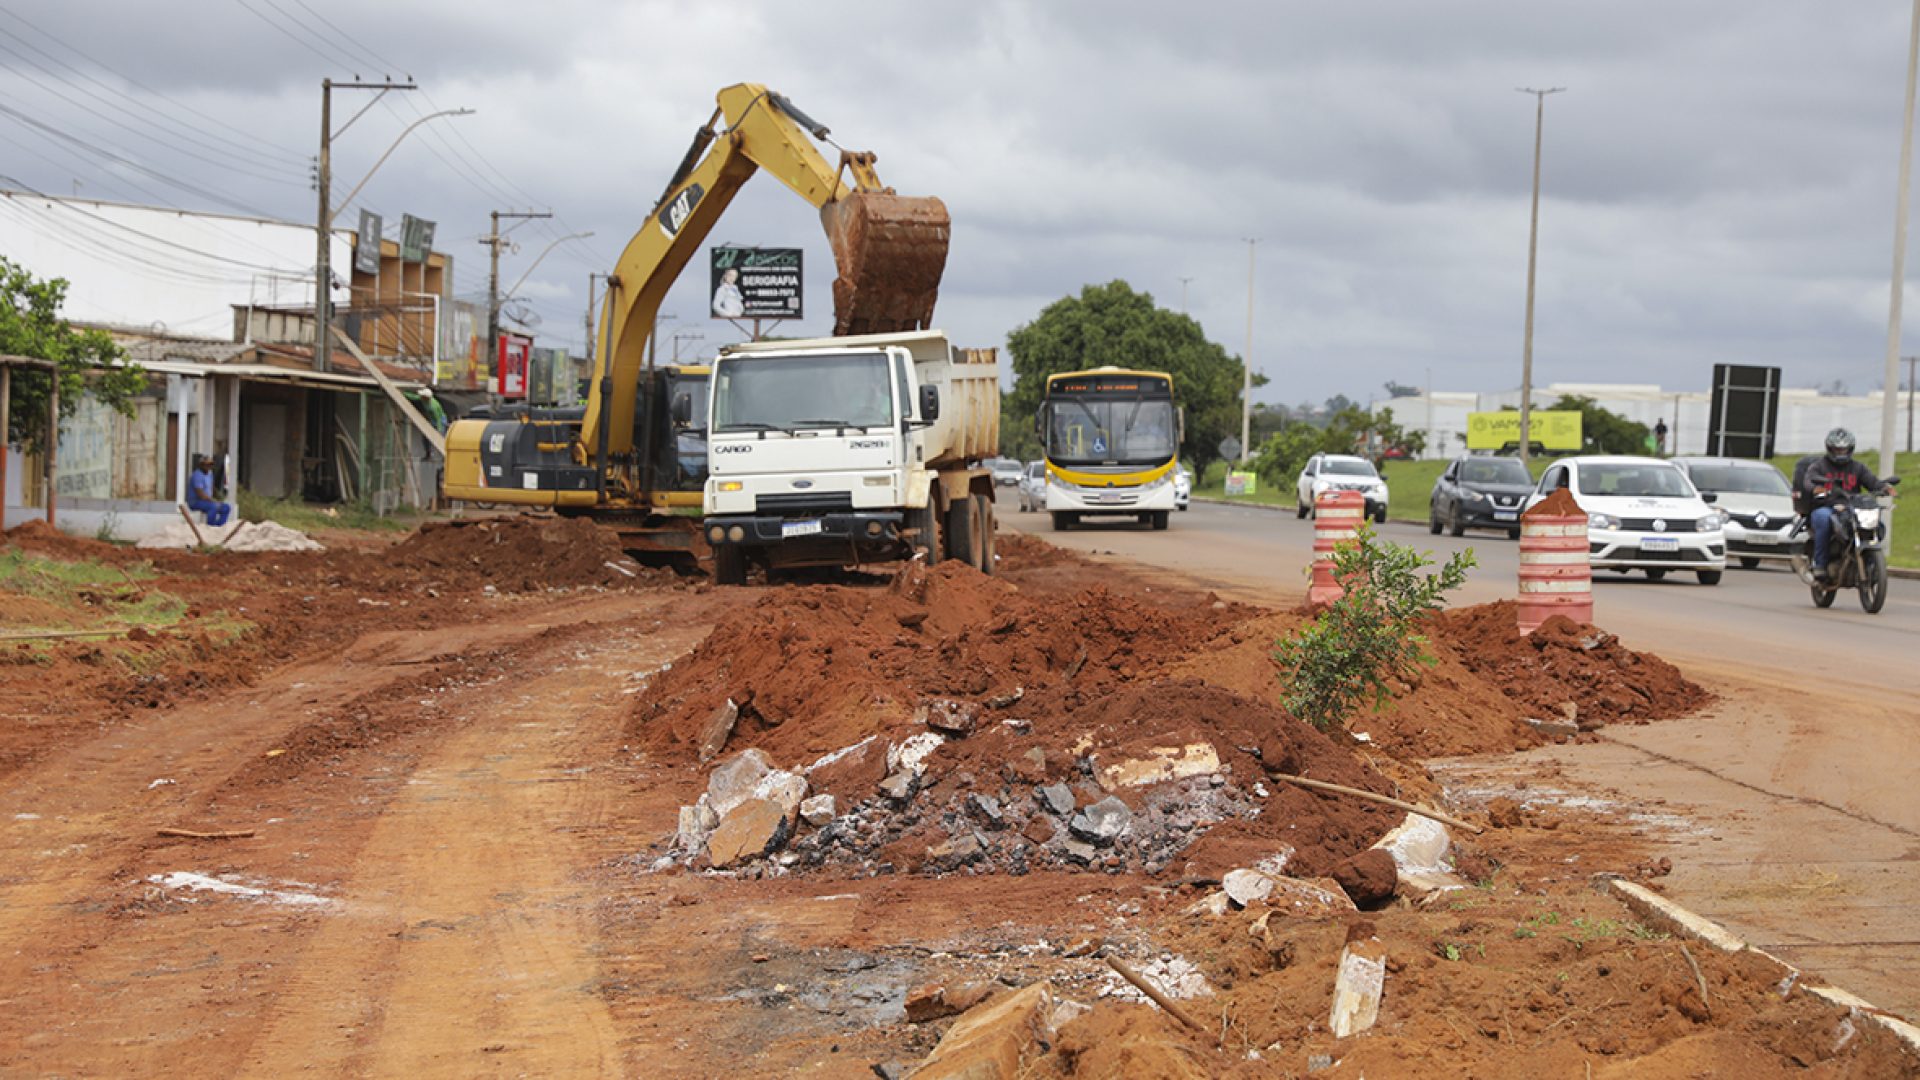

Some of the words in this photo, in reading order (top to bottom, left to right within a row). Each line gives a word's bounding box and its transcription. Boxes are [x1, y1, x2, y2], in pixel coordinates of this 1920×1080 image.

[670, 191, 690, 230] CAT
[742, 275, 799, 286] SERIGRAFIA
[1489, 419, 1544, 430] VAMS?
[715, 445, 752, 454] CARGO
